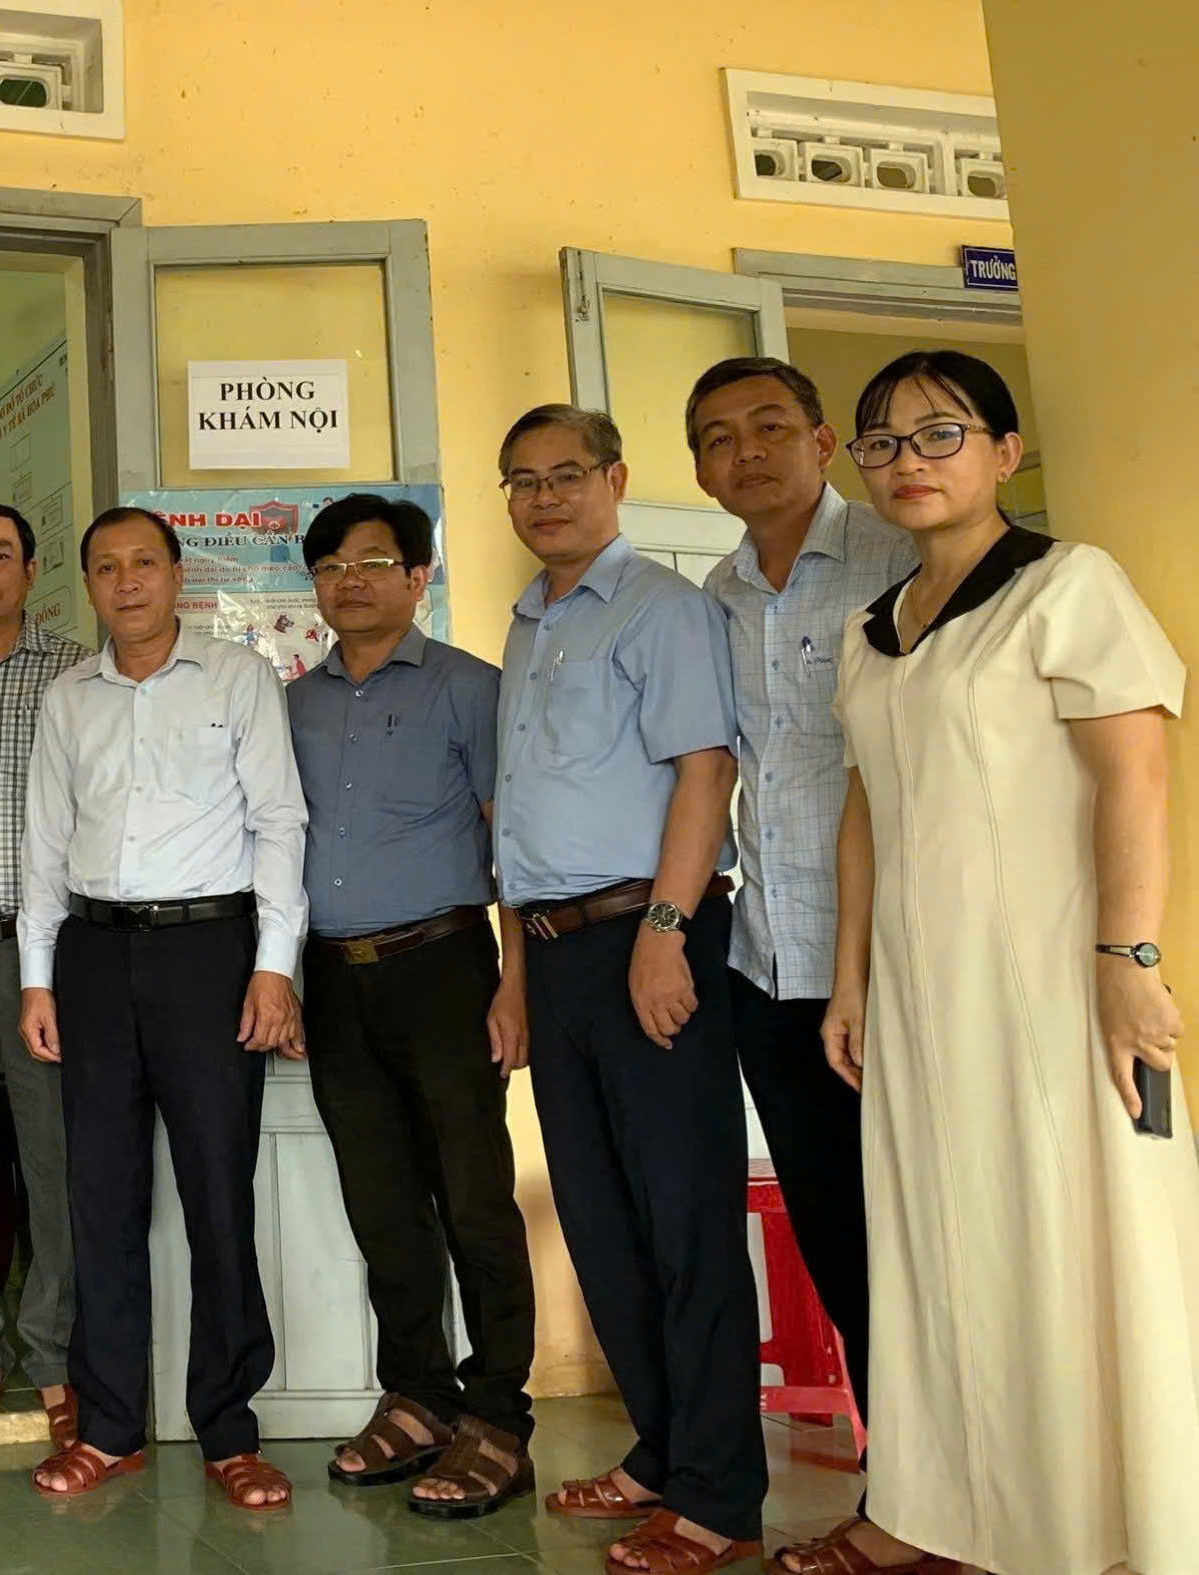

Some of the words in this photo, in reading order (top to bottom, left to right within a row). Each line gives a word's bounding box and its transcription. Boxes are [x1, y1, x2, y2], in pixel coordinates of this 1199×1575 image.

[970, 255, 1016, 280] TRƯỞNG
[220, 376, 315, 401] PHÒNG
[199, 406, 280, 431] KHÁM
[290, 408, 338, 433] NỘI
[215, 512, 262, 529] DẠI
[201, 532, 248, 547] ĐIỀU
